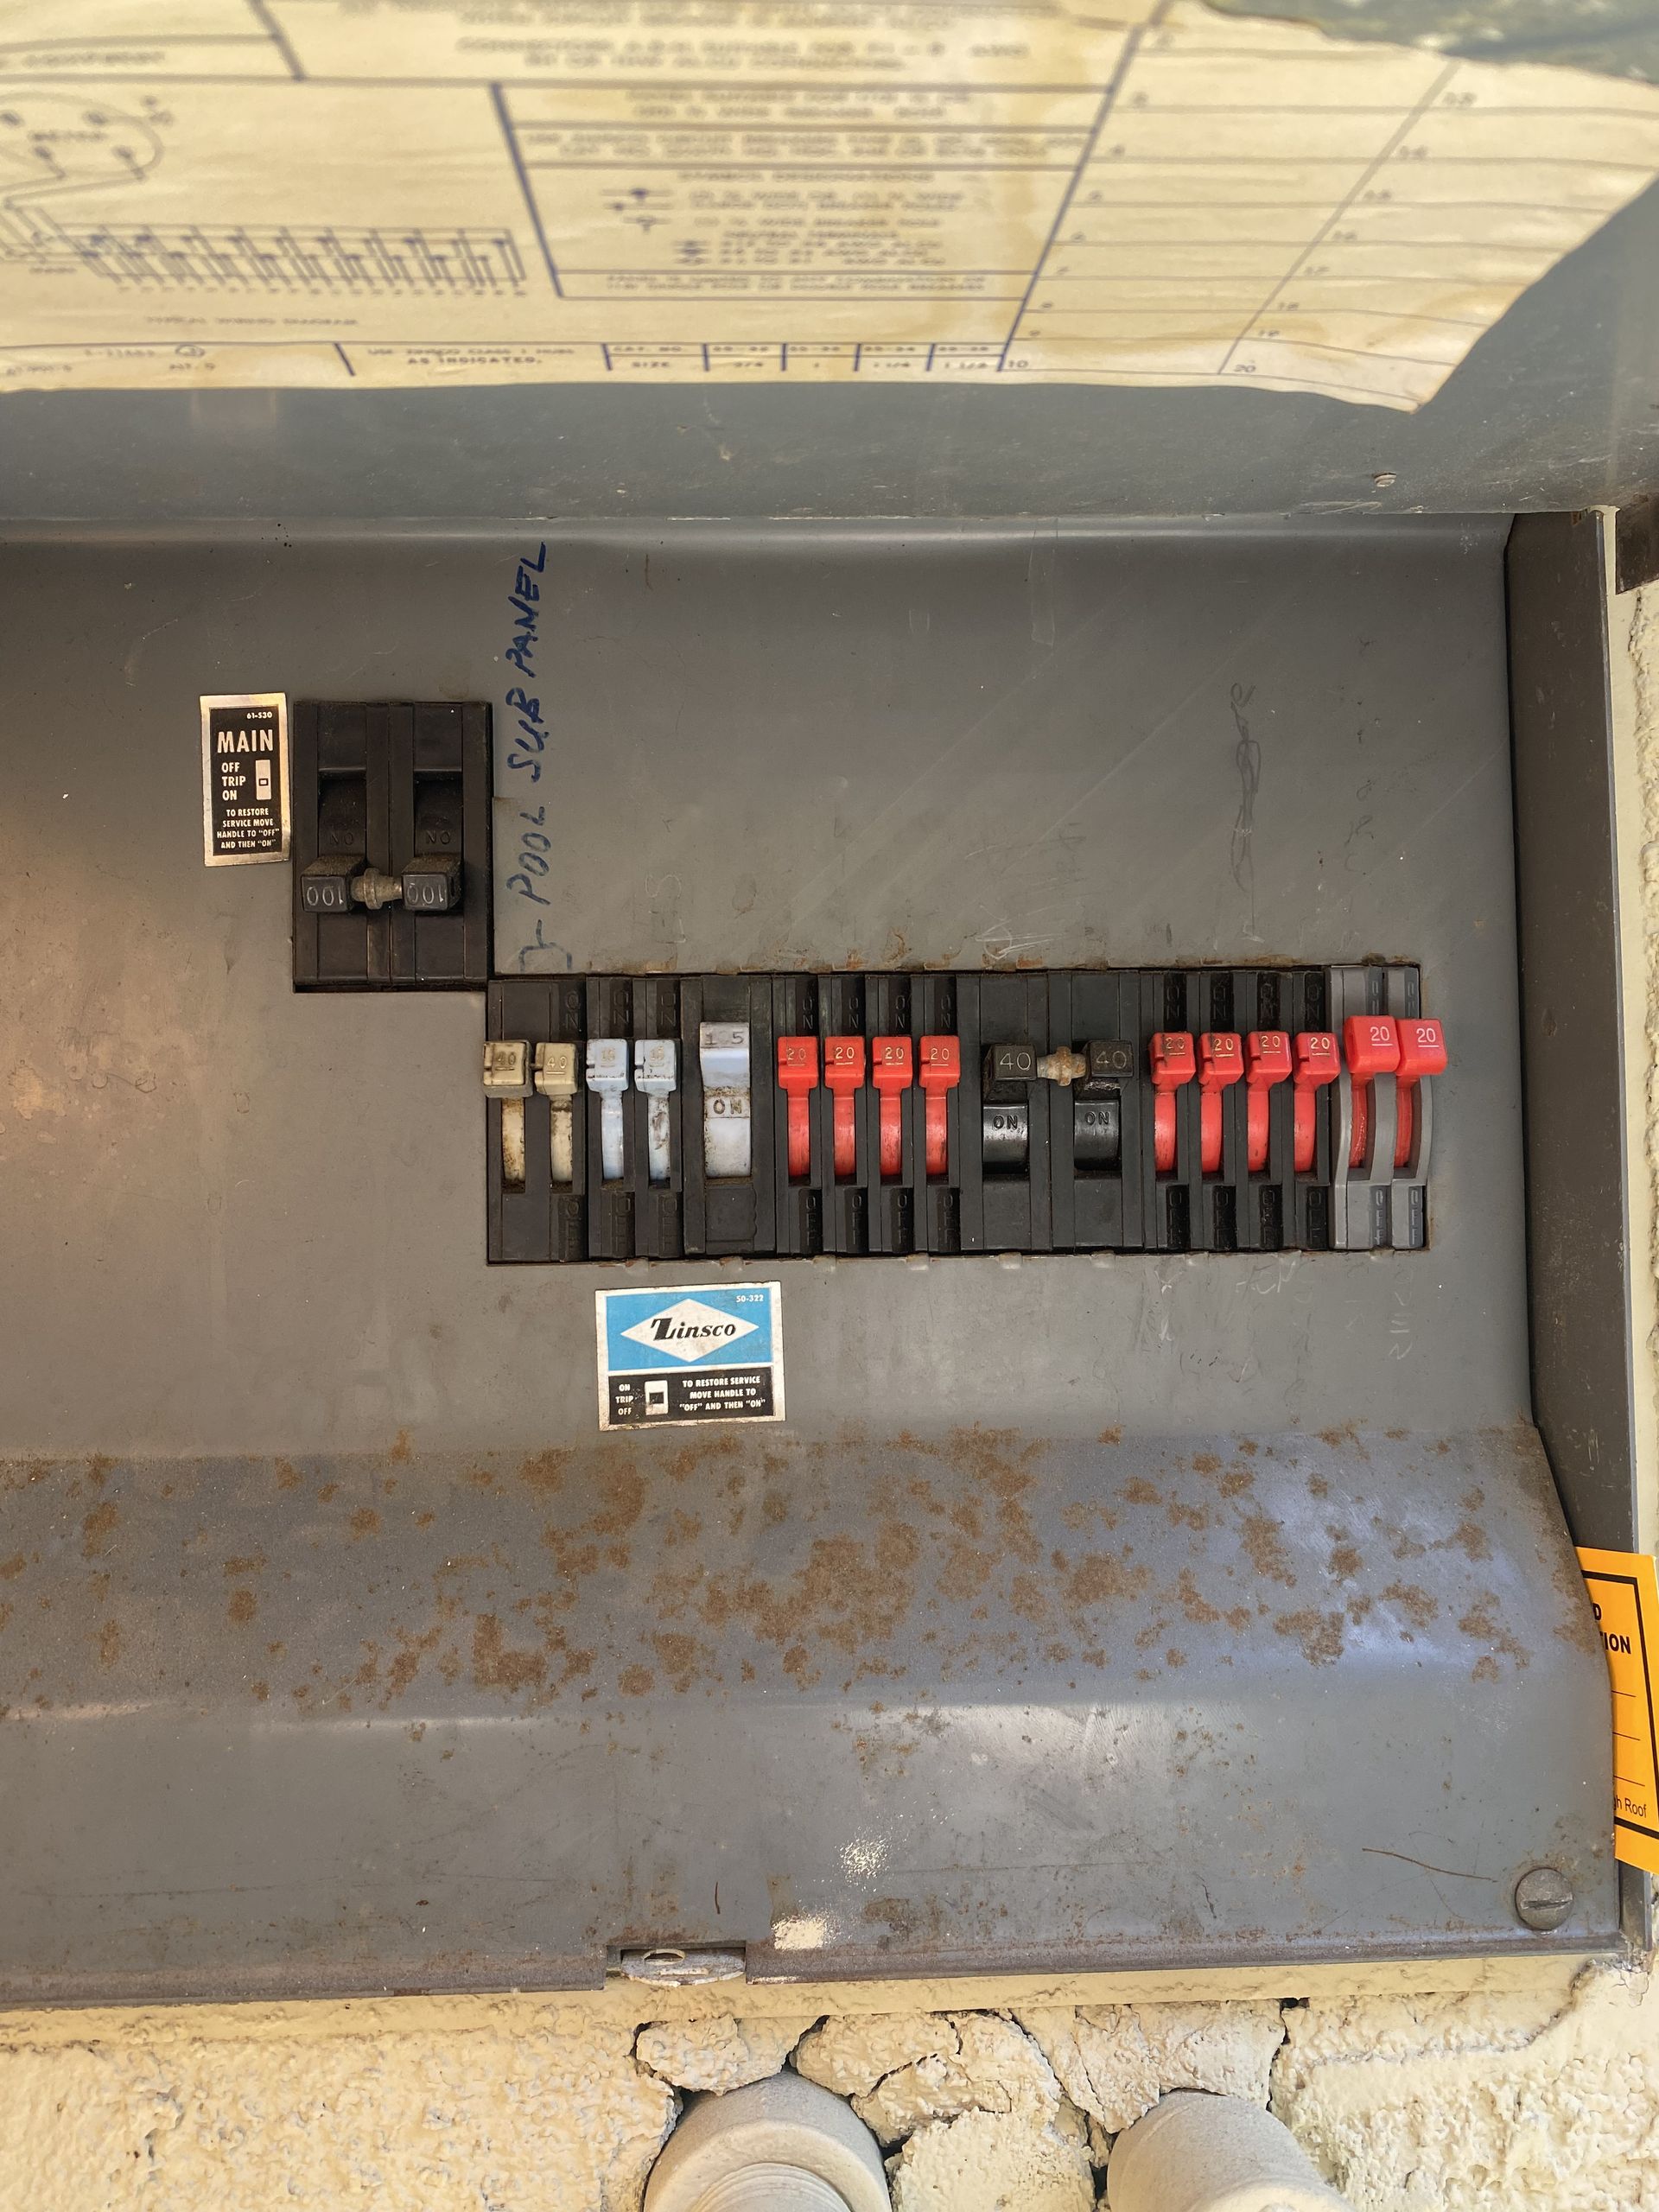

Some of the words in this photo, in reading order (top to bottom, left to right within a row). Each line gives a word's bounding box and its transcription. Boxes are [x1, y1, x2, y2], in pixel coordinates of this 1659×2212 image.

[1007, 359, 1029, 369] 10
[1233, 363, 1257, 373] 20
[505, 541, 547, 678] PANEL
[246, 711, 273, 720] 61-530
[217, 729, 274, 753] MAIN
[505, 687, 550, 783] SUB
[221, 762, 240, 773] OFF
[221, 776, 246, 787] TRIP
[222, 790, 238, 801] ON
[226, 809, 237, 817] TO
[238, 807, 269, 817] RESTORE
[222, 819, 251, 828] SERVICE
[253, 818, 274, 827] MOVE
[217, 830, 245, 838] HANDLE
[220, 841, 236, 849] AND
[238, 839, 256, 848] THEN
[505, 805, 551, 906] POOL
[1370, 1026, 1390, 1041] 20
[1416, 1027, 1436, 1043] 20
[1214, 1038, 1234, 1051] 20
[1262, 1035, 1281, 1048] 20
[1309, 1037, 1331, 1049] 20
[495, 1052, 517, 1065] 40
[786, 1046, 807, 1061] 20
[835, 1046, 855, 1059] 20
[884, 1046, 905, 1059] 20
[930, 1047, 950, 1061] 20
[546, 1056, 569, 1070] 40
[1000, 1052, 1032, 1071] 40
[1096, 1050, 1128, 1070] 40
[713, 1098, 742, 1115] ON
[993, 1114, 1018, 1130] ON
[1084, 1110, 1109, 1126] ON
[735, 1294, 764, 1303] 50-322
[651, 1317, 736, 1341] Zinsco
[619, 1383, 631, 1392] ON
[696, 1377, 728, 1387] RESTORE
[730, 1376, 760, 1385] SERVICE
[615, 1395, 634, 1404] TRIP
[690, 1391, 712, 1400] MOVE
[714, 1389, 743, 1398] HANDLE
[746, 1388, 757, 1396] TO
[618, 1407, 632, 1415] OFF
[705, 1402, 721, 1410] AND
[724, 1400, 744, 1409] THEN
[1624, 1797, 1646, 1818] Roof
